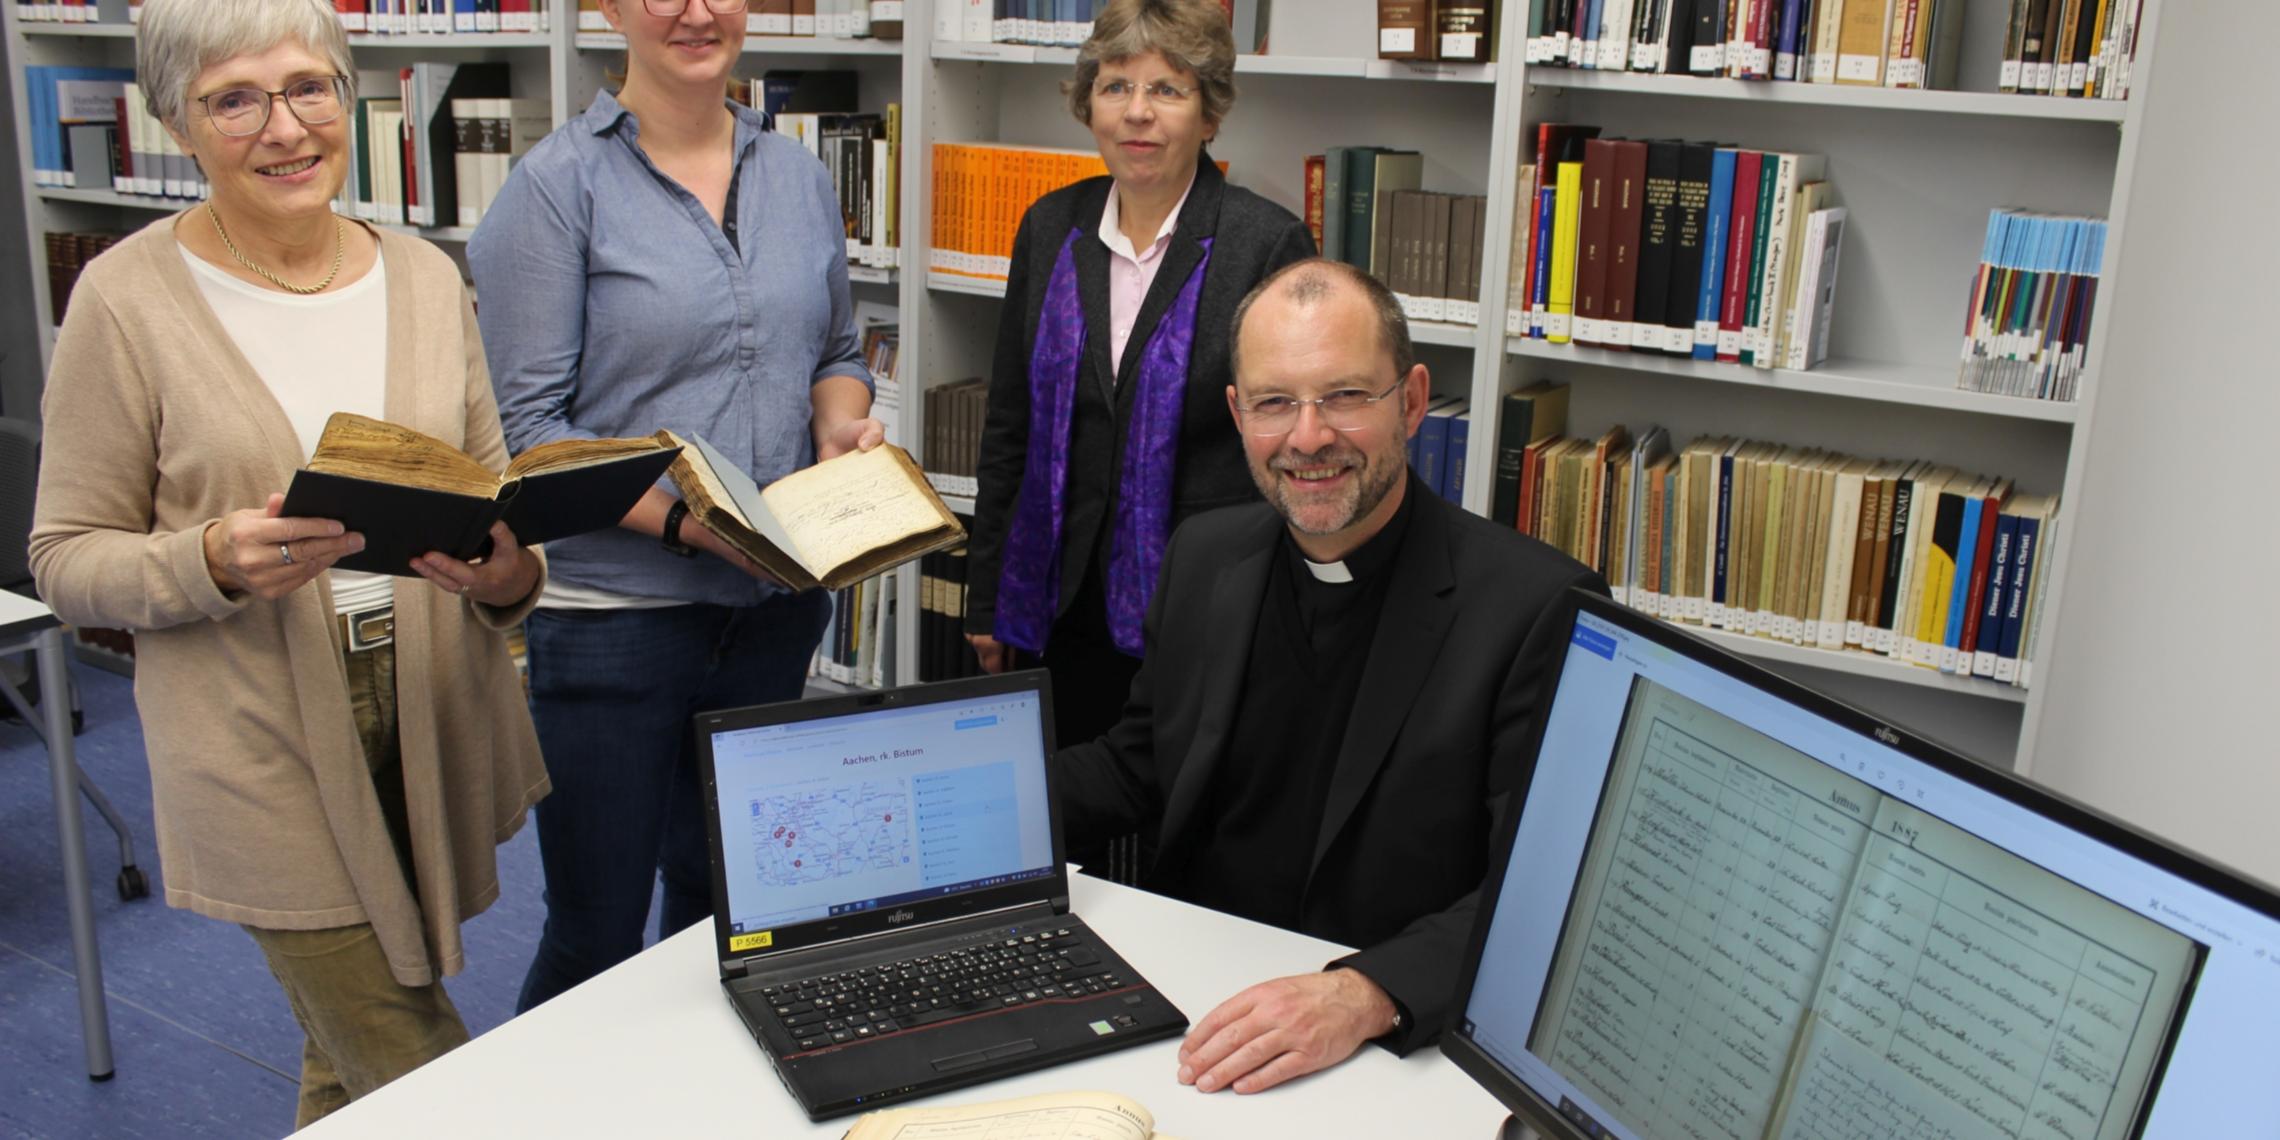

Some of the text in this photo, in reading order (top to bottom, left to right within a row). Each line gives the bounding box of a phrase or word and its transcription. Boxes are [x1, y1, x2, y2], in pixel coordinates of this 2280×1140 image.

[1862, 493, 1879, 541] WENAU
[1877, 494, 1893, 543] WENAU
[1893, 489, 1910, 536] WENAU
[1996, 533, 2010, 564] Christi
[2017, 534, 2031, 565] Christi
[1874, 727, 1900, 745] FUJITSU
[842, 746, 924, 767] Aachen, rk. Bistum
[888, 910, 914, 923] FUJITSU
[736, 935, 767, 947] P 5566
